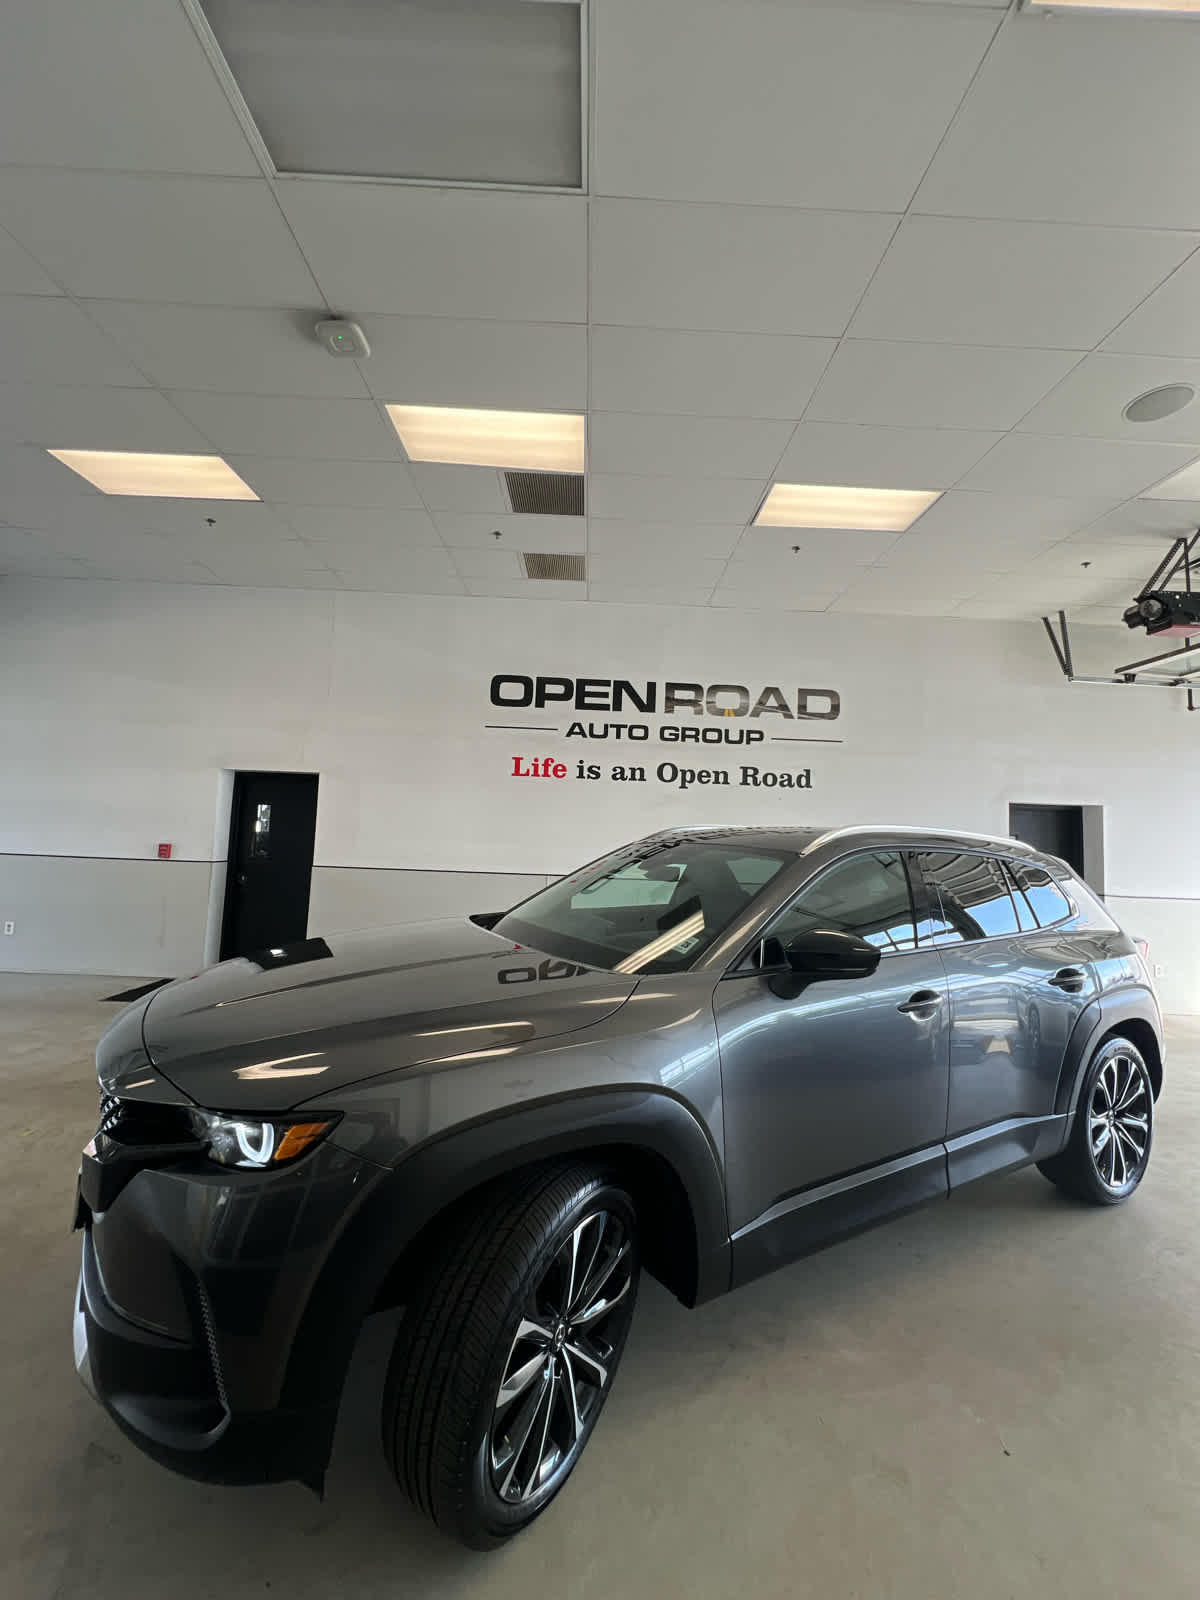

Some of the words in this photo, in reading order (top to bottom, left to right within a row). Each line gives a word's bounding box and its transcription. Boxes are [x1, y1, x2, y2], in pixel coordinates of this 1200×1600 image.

[565, 722, 649, 740] AUTO
[660, 726, 764, 745] GROUP
[511, 757, 567, 778] Life
[576, 760, 601, 780] is
[611, 765, 647, 782] an
[657, 762, 730, 789] Open
[739, 766, 812, 788] Road
